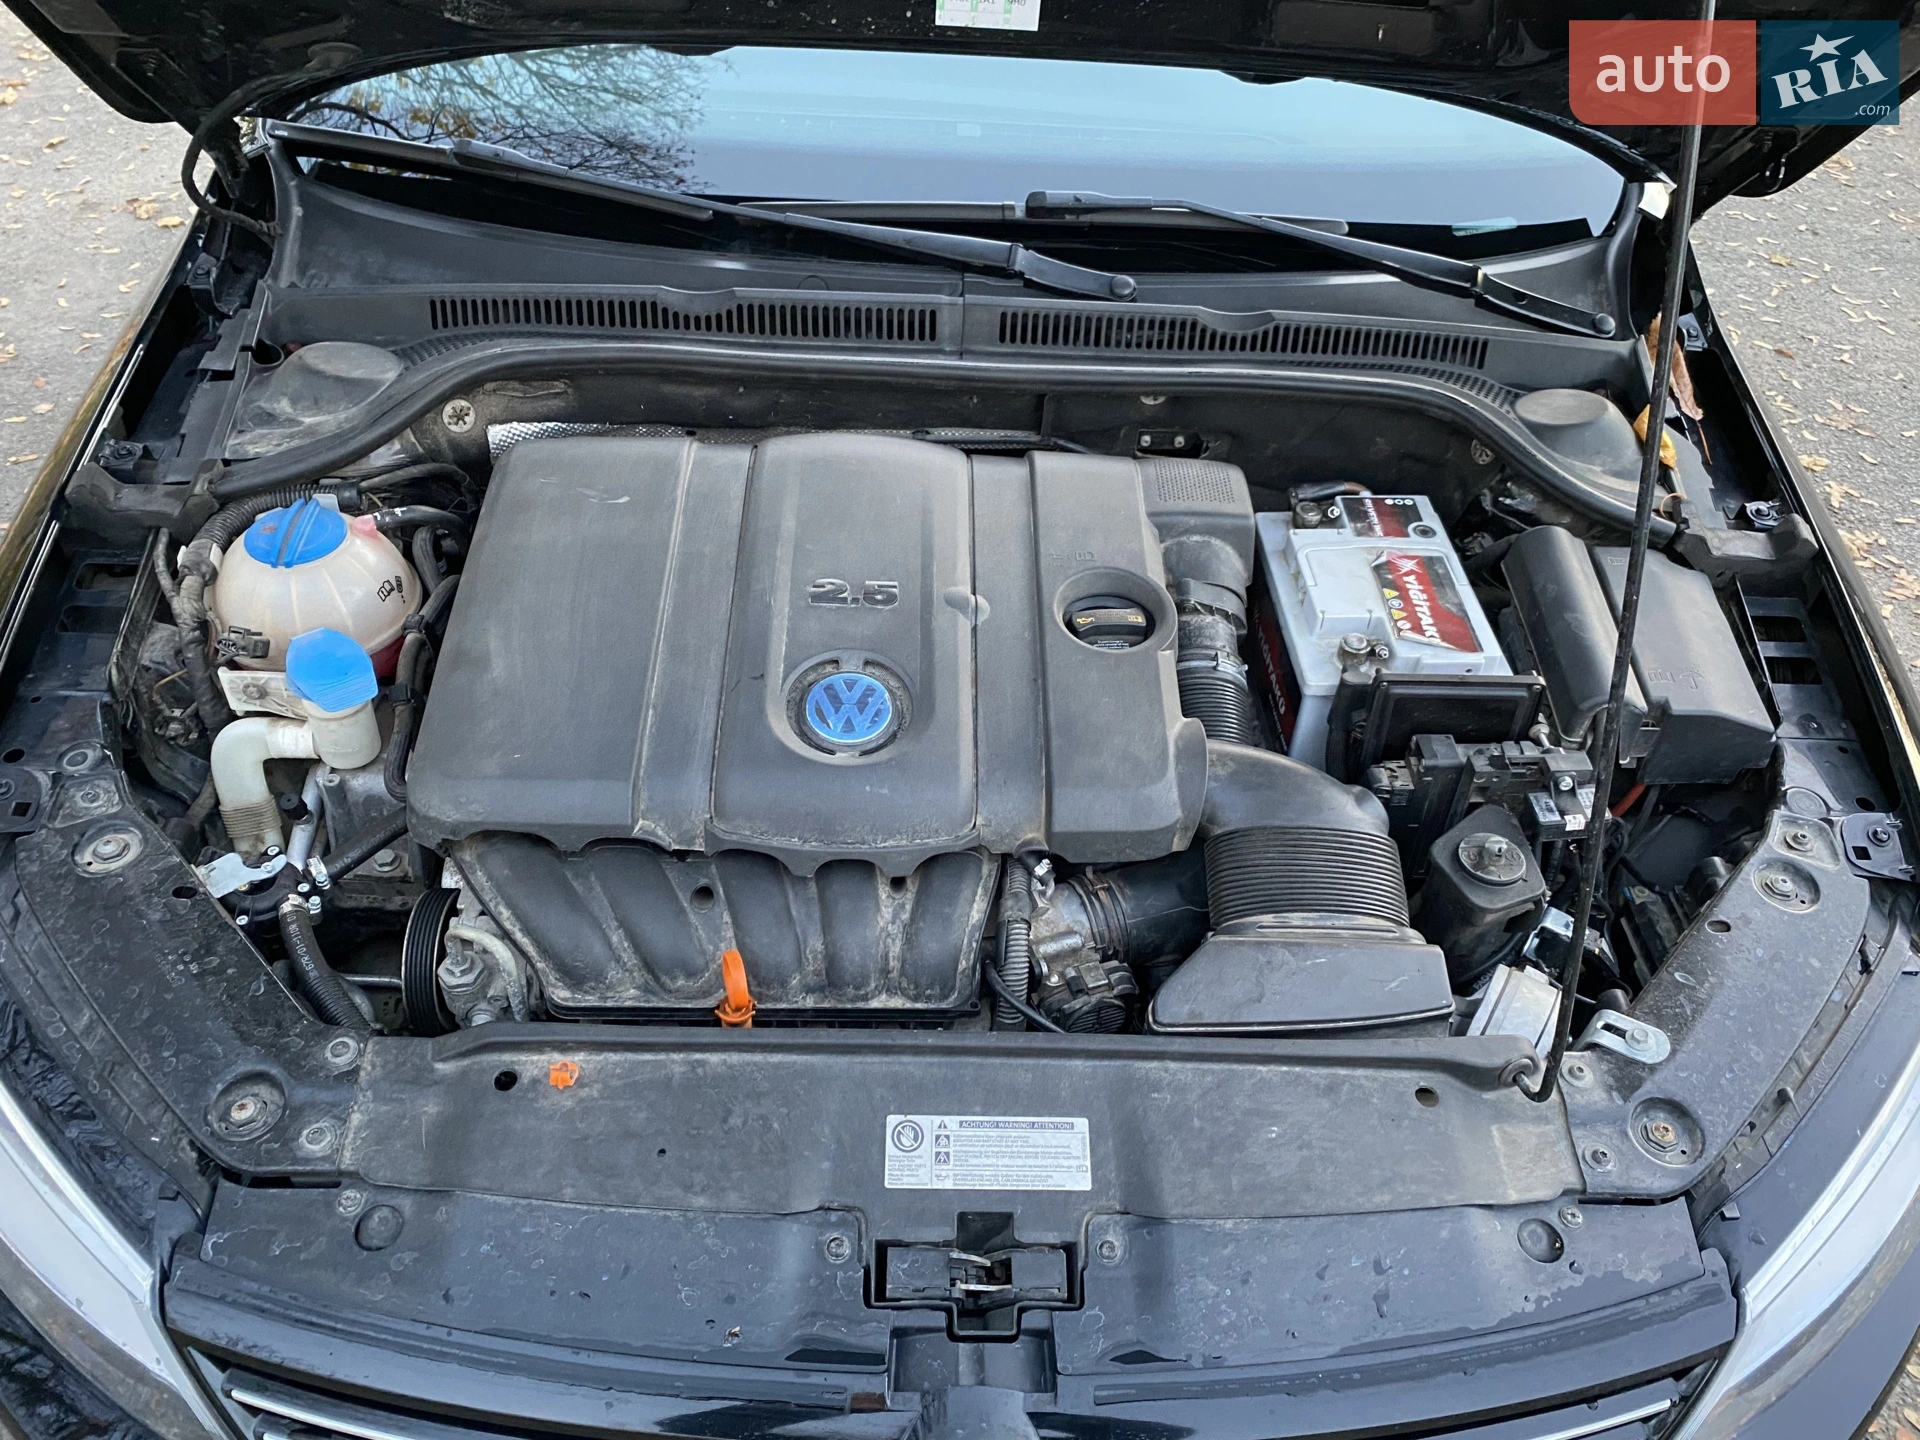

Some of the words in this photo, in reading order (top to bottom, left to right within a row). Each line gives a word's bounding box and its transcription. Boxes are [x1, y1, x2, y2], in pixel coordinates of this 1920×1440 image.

[808, 578, 899, 608] 2.5
[807, 674, 891, 741] VW
[961, 1120, 997, 1128] ACHTUNG!
[997, 1121, 1033, 1129] WARNING!
[1033, 1122, 1072, 1130] ATTENTION!
